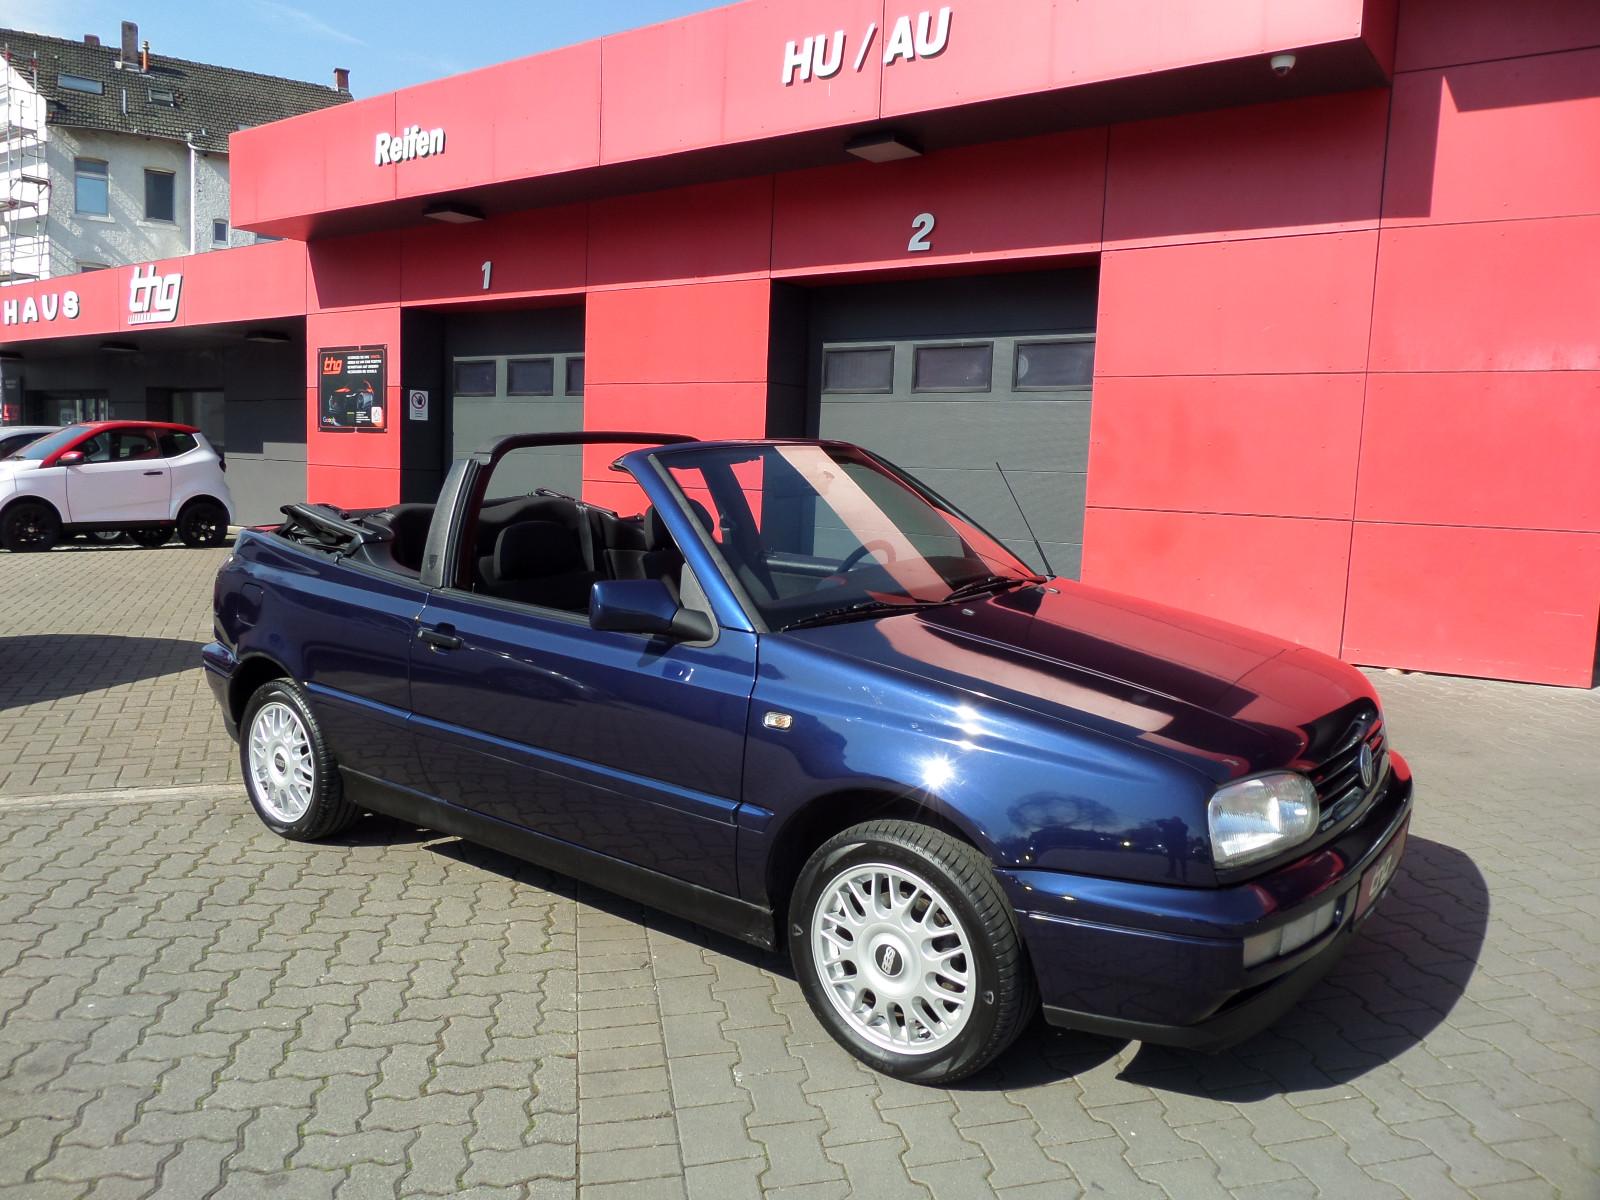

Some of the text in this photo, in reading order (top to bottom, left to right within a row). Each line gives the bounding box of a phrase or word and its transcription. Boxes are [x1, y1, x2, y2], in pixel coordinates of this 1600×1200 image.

[782, 6, 952, 86] HU / AU
[374, 124, 446, 167] Reifen
[907, 212, 935, 251] 2
[481, 260, 492, 289] 1
[3, 290, 80, 326] HAUS
[128, 264, 183, 325] thg
[322, 356, 343, 375] thg
